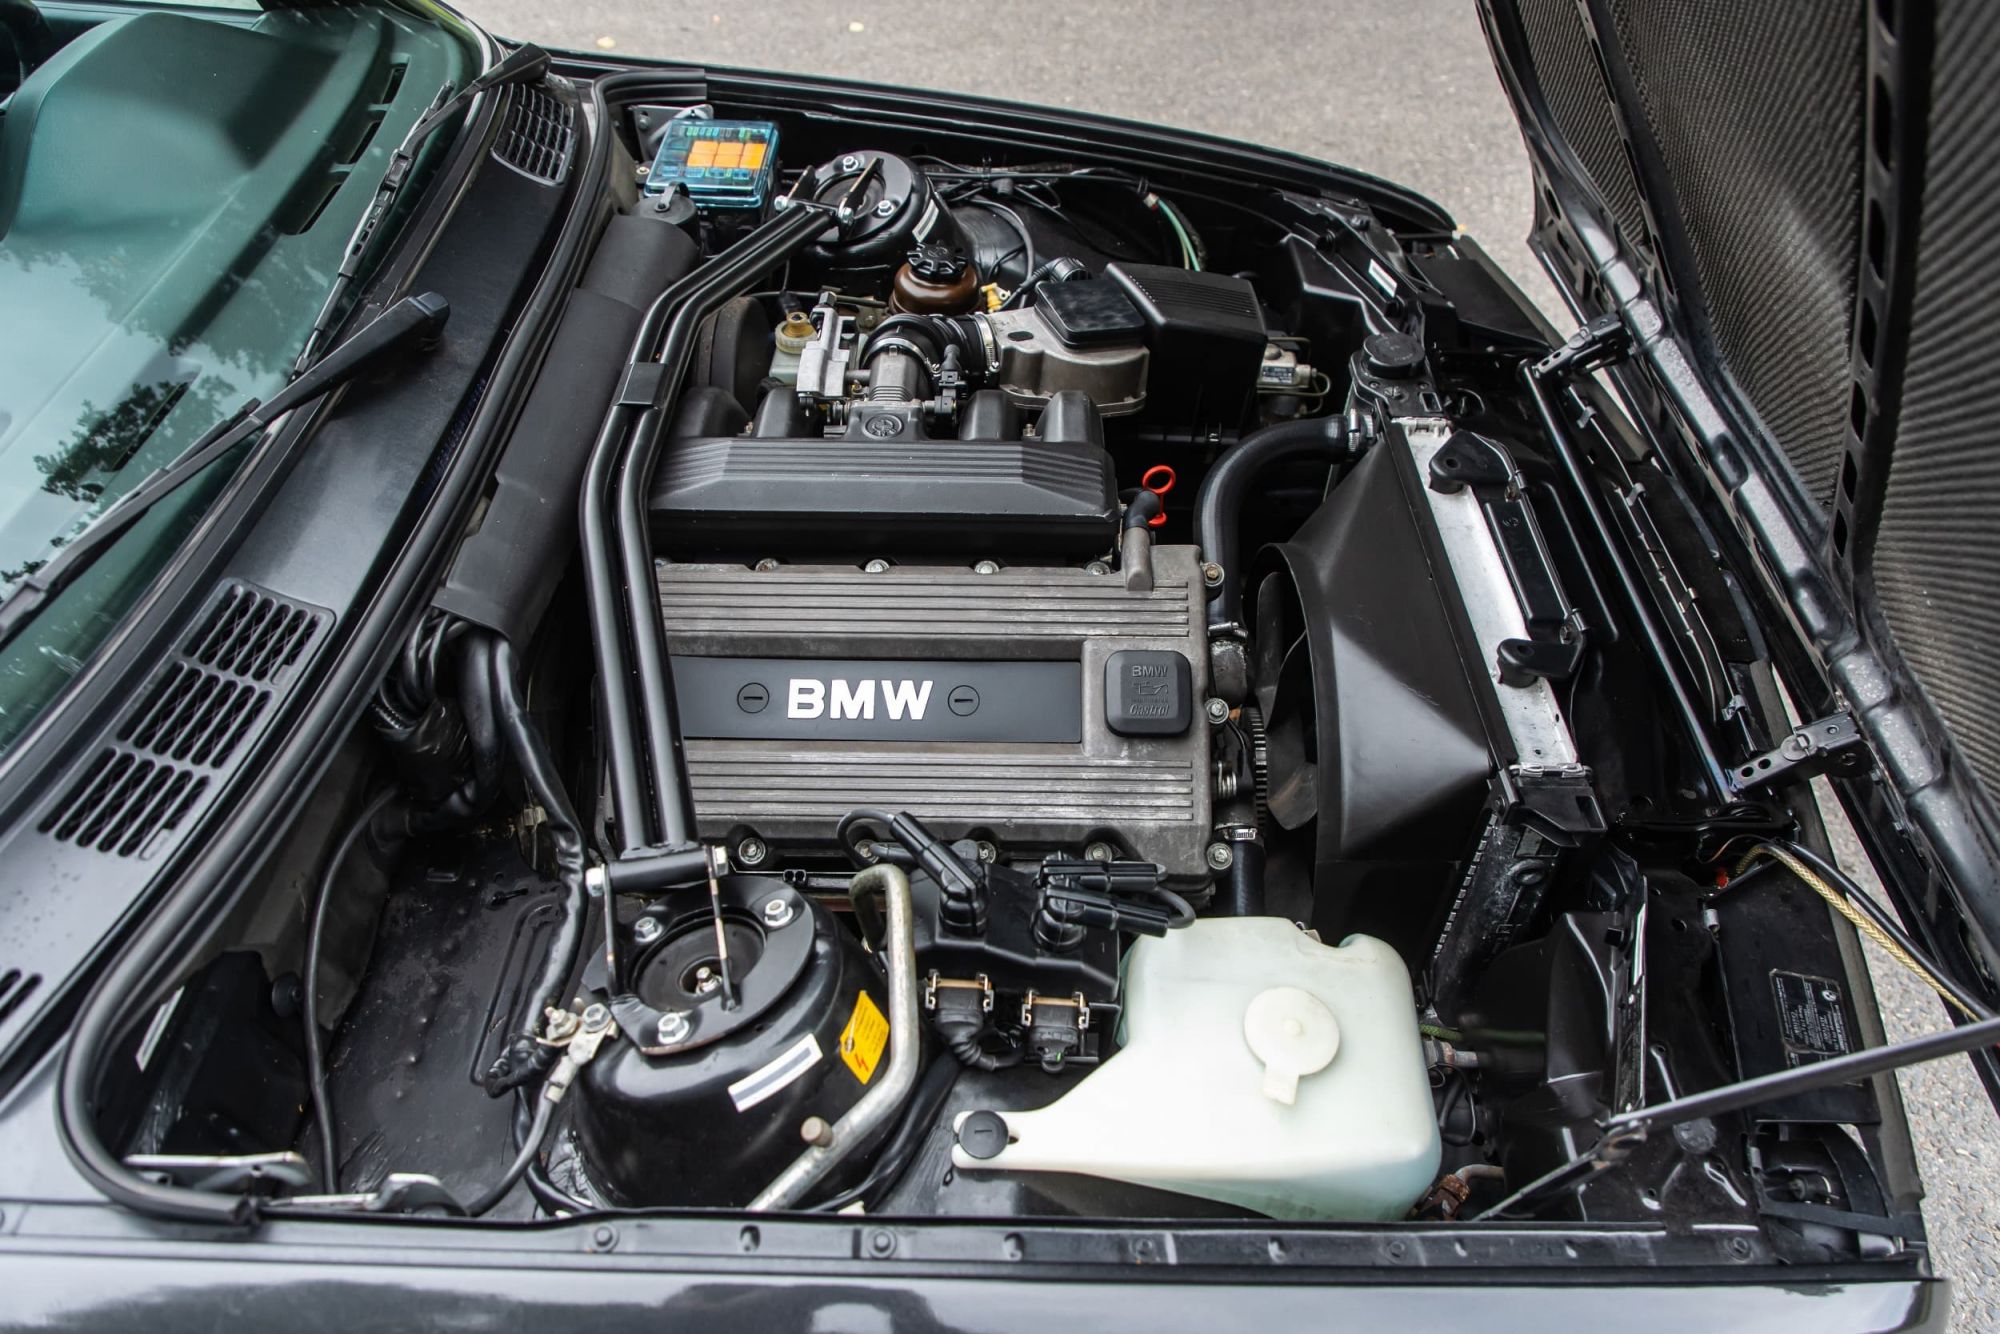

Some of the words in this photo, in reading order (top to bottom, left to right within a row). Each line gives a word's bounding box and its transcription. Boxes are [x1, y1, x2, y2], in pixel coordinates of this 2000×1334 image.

[1132, 665, 1167, 677] BMW
[788, 678, 934, 720] BMW
[1129, 703, 1169, 717] Castrol
